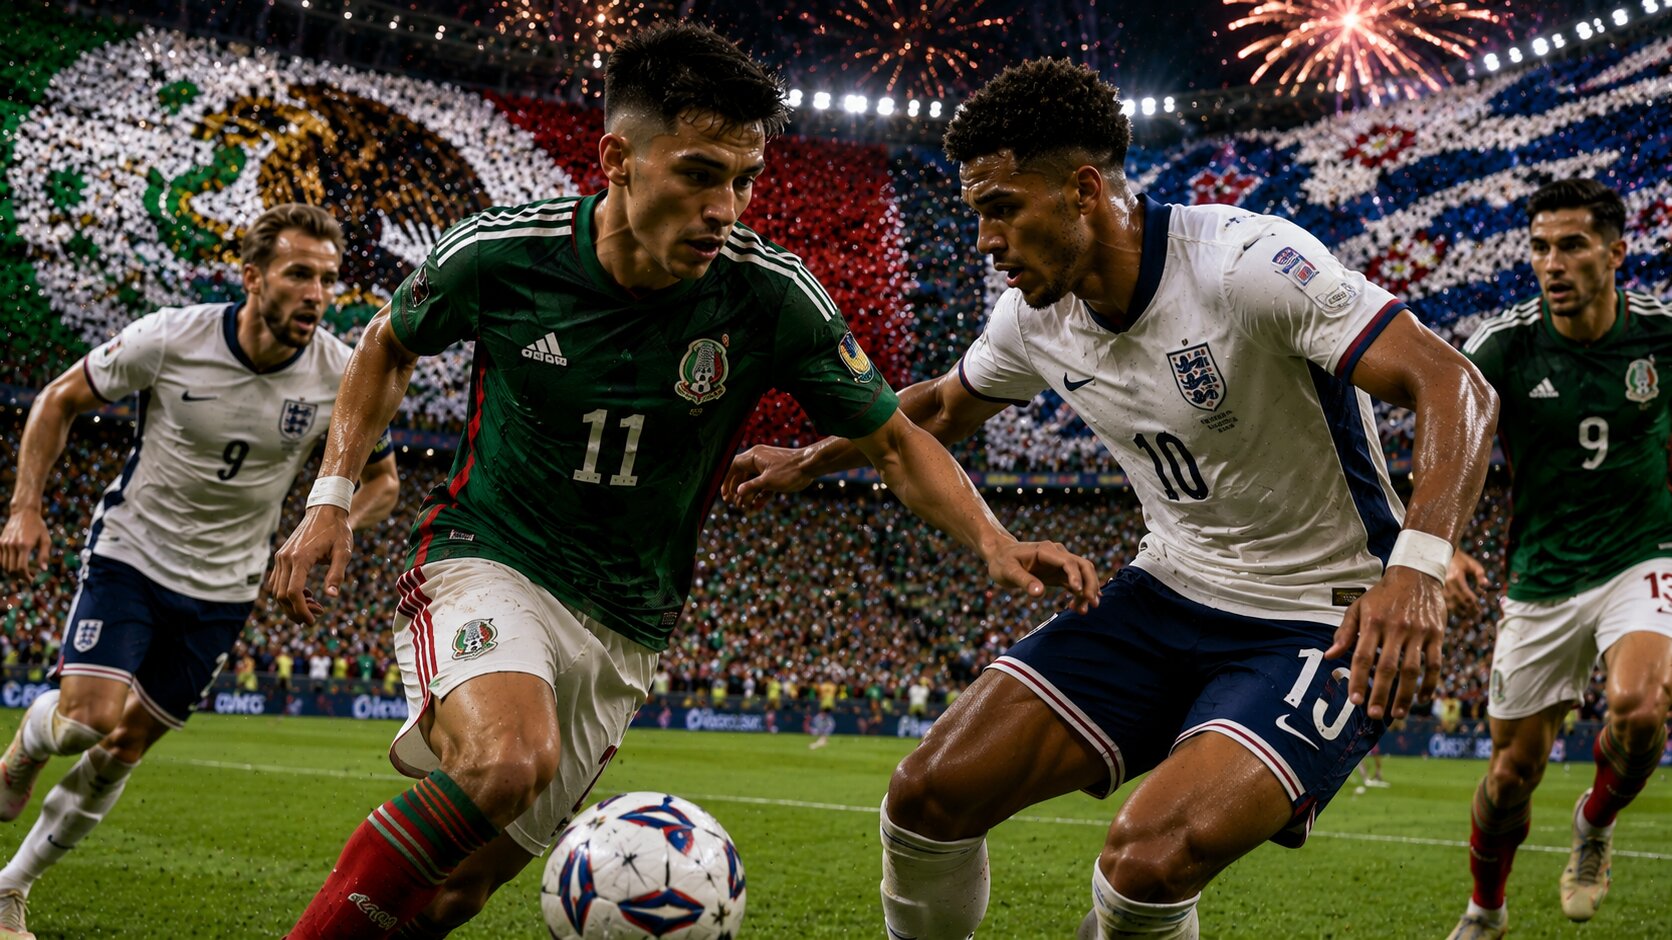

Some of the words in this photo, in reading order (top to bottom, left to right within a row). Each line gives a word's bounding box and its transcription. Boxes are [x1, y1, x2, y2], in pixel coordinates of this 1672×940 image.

[217, 440, 250, 481] 9
[572, 408, 645, 487] 11
[1133, 431, 1209, 501] 10
[1578, 416, 1609, 470] 9
